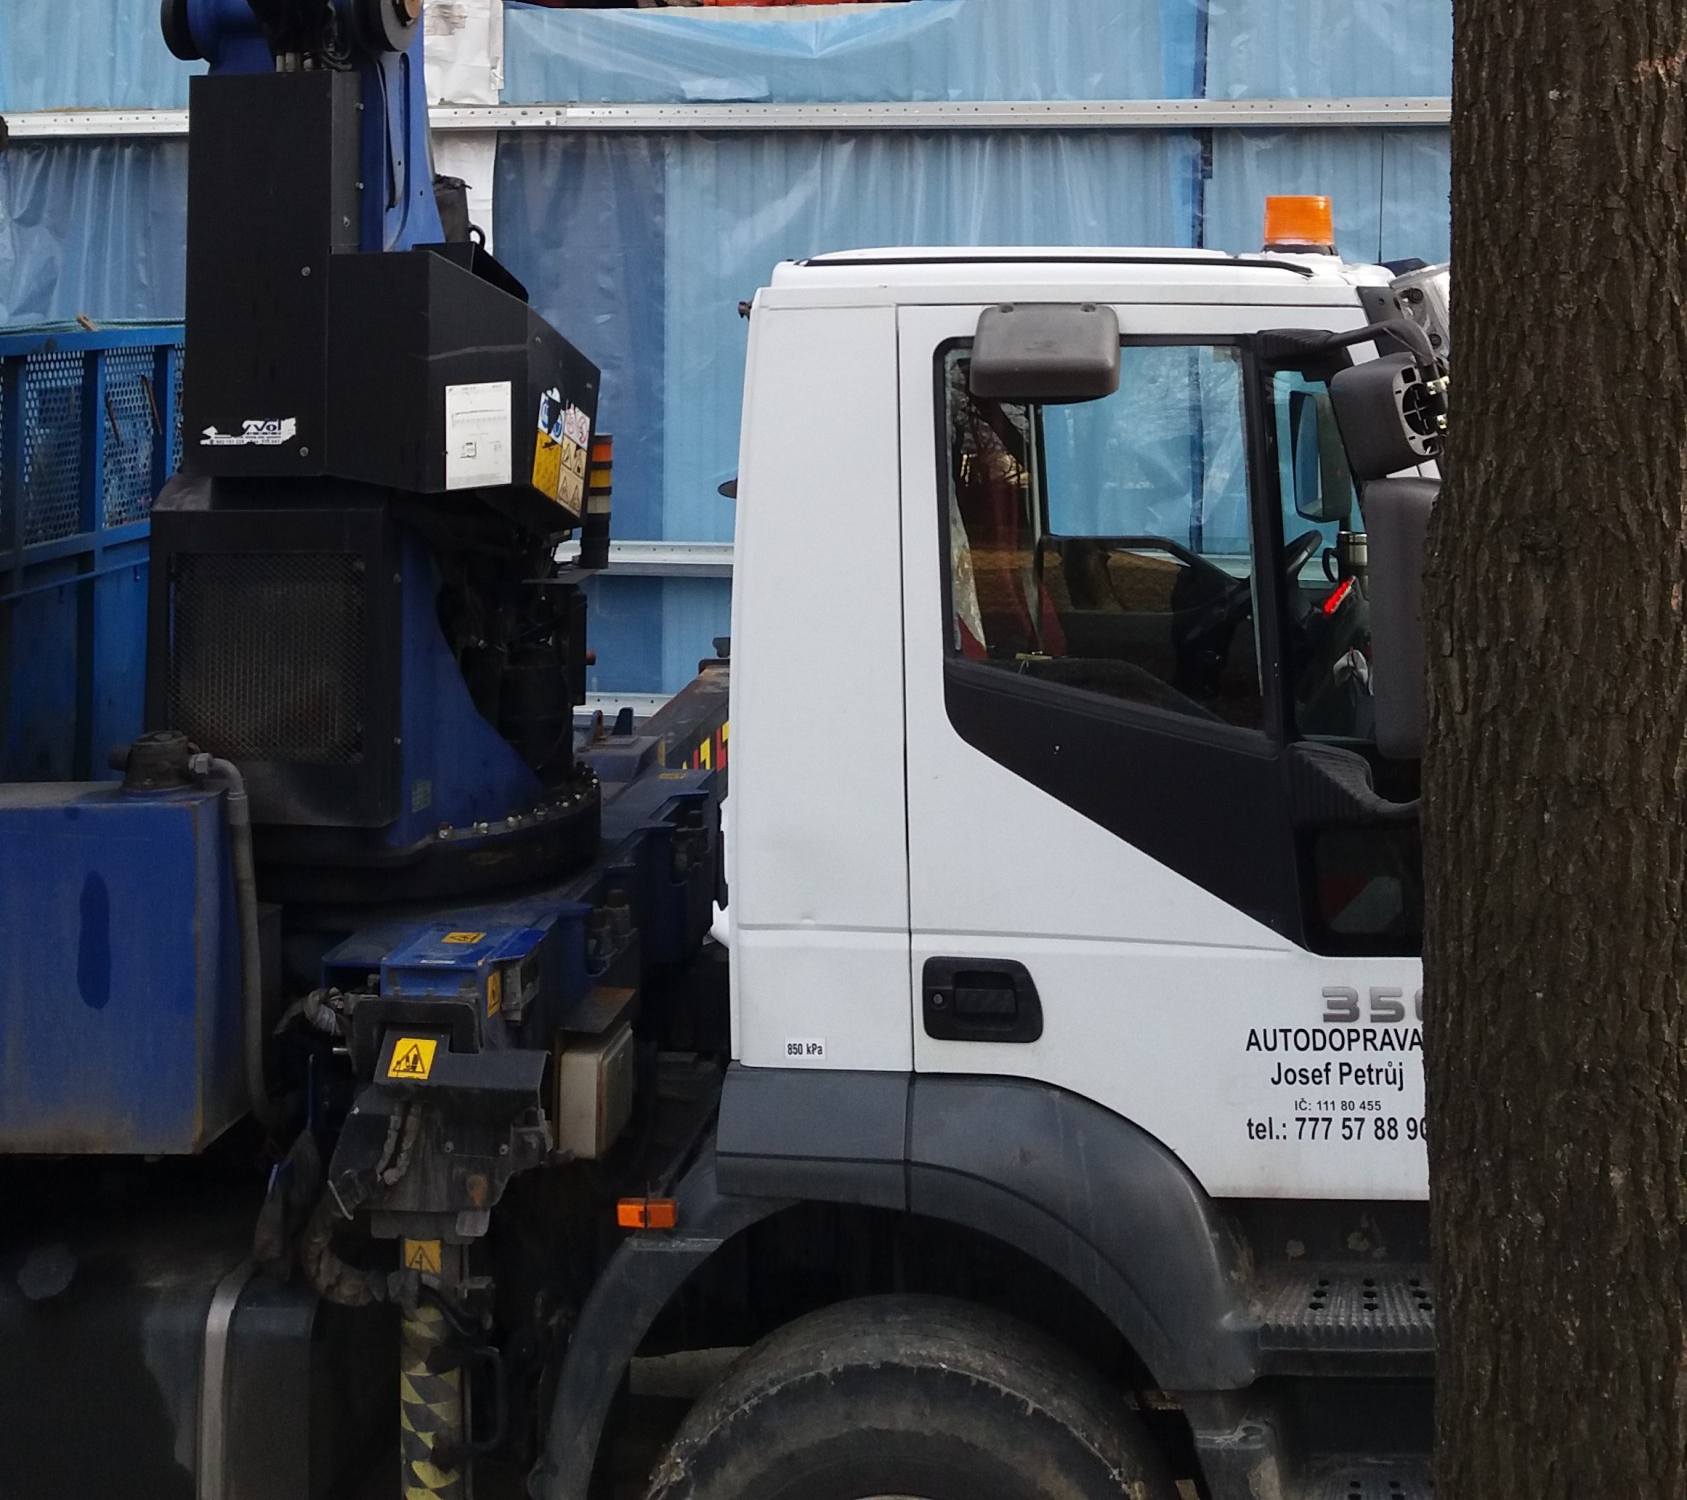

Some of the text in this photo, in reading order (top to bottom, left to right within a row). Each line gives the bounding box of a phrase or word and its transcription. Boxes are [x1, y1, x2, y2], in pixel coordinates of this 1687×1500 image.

[1322, 986, 1423, 1023] 35
[787, 1043, 823, 1055] 850 kPa
[1246, 1028, 1423, 1051] AUTODOPRAVA
[1270, 1061, 1404, 1092] Josef Petrůj
[1294, 1098, 1382, 1111] IČ: 111 80 455
[1247, 1117, 1287, 1140] tel.:
[1295, 1117, 1333, 1140] 777
[1341, 1117, 1365, 1140] 57
[1374, 1117, 1399, 1140] 88
